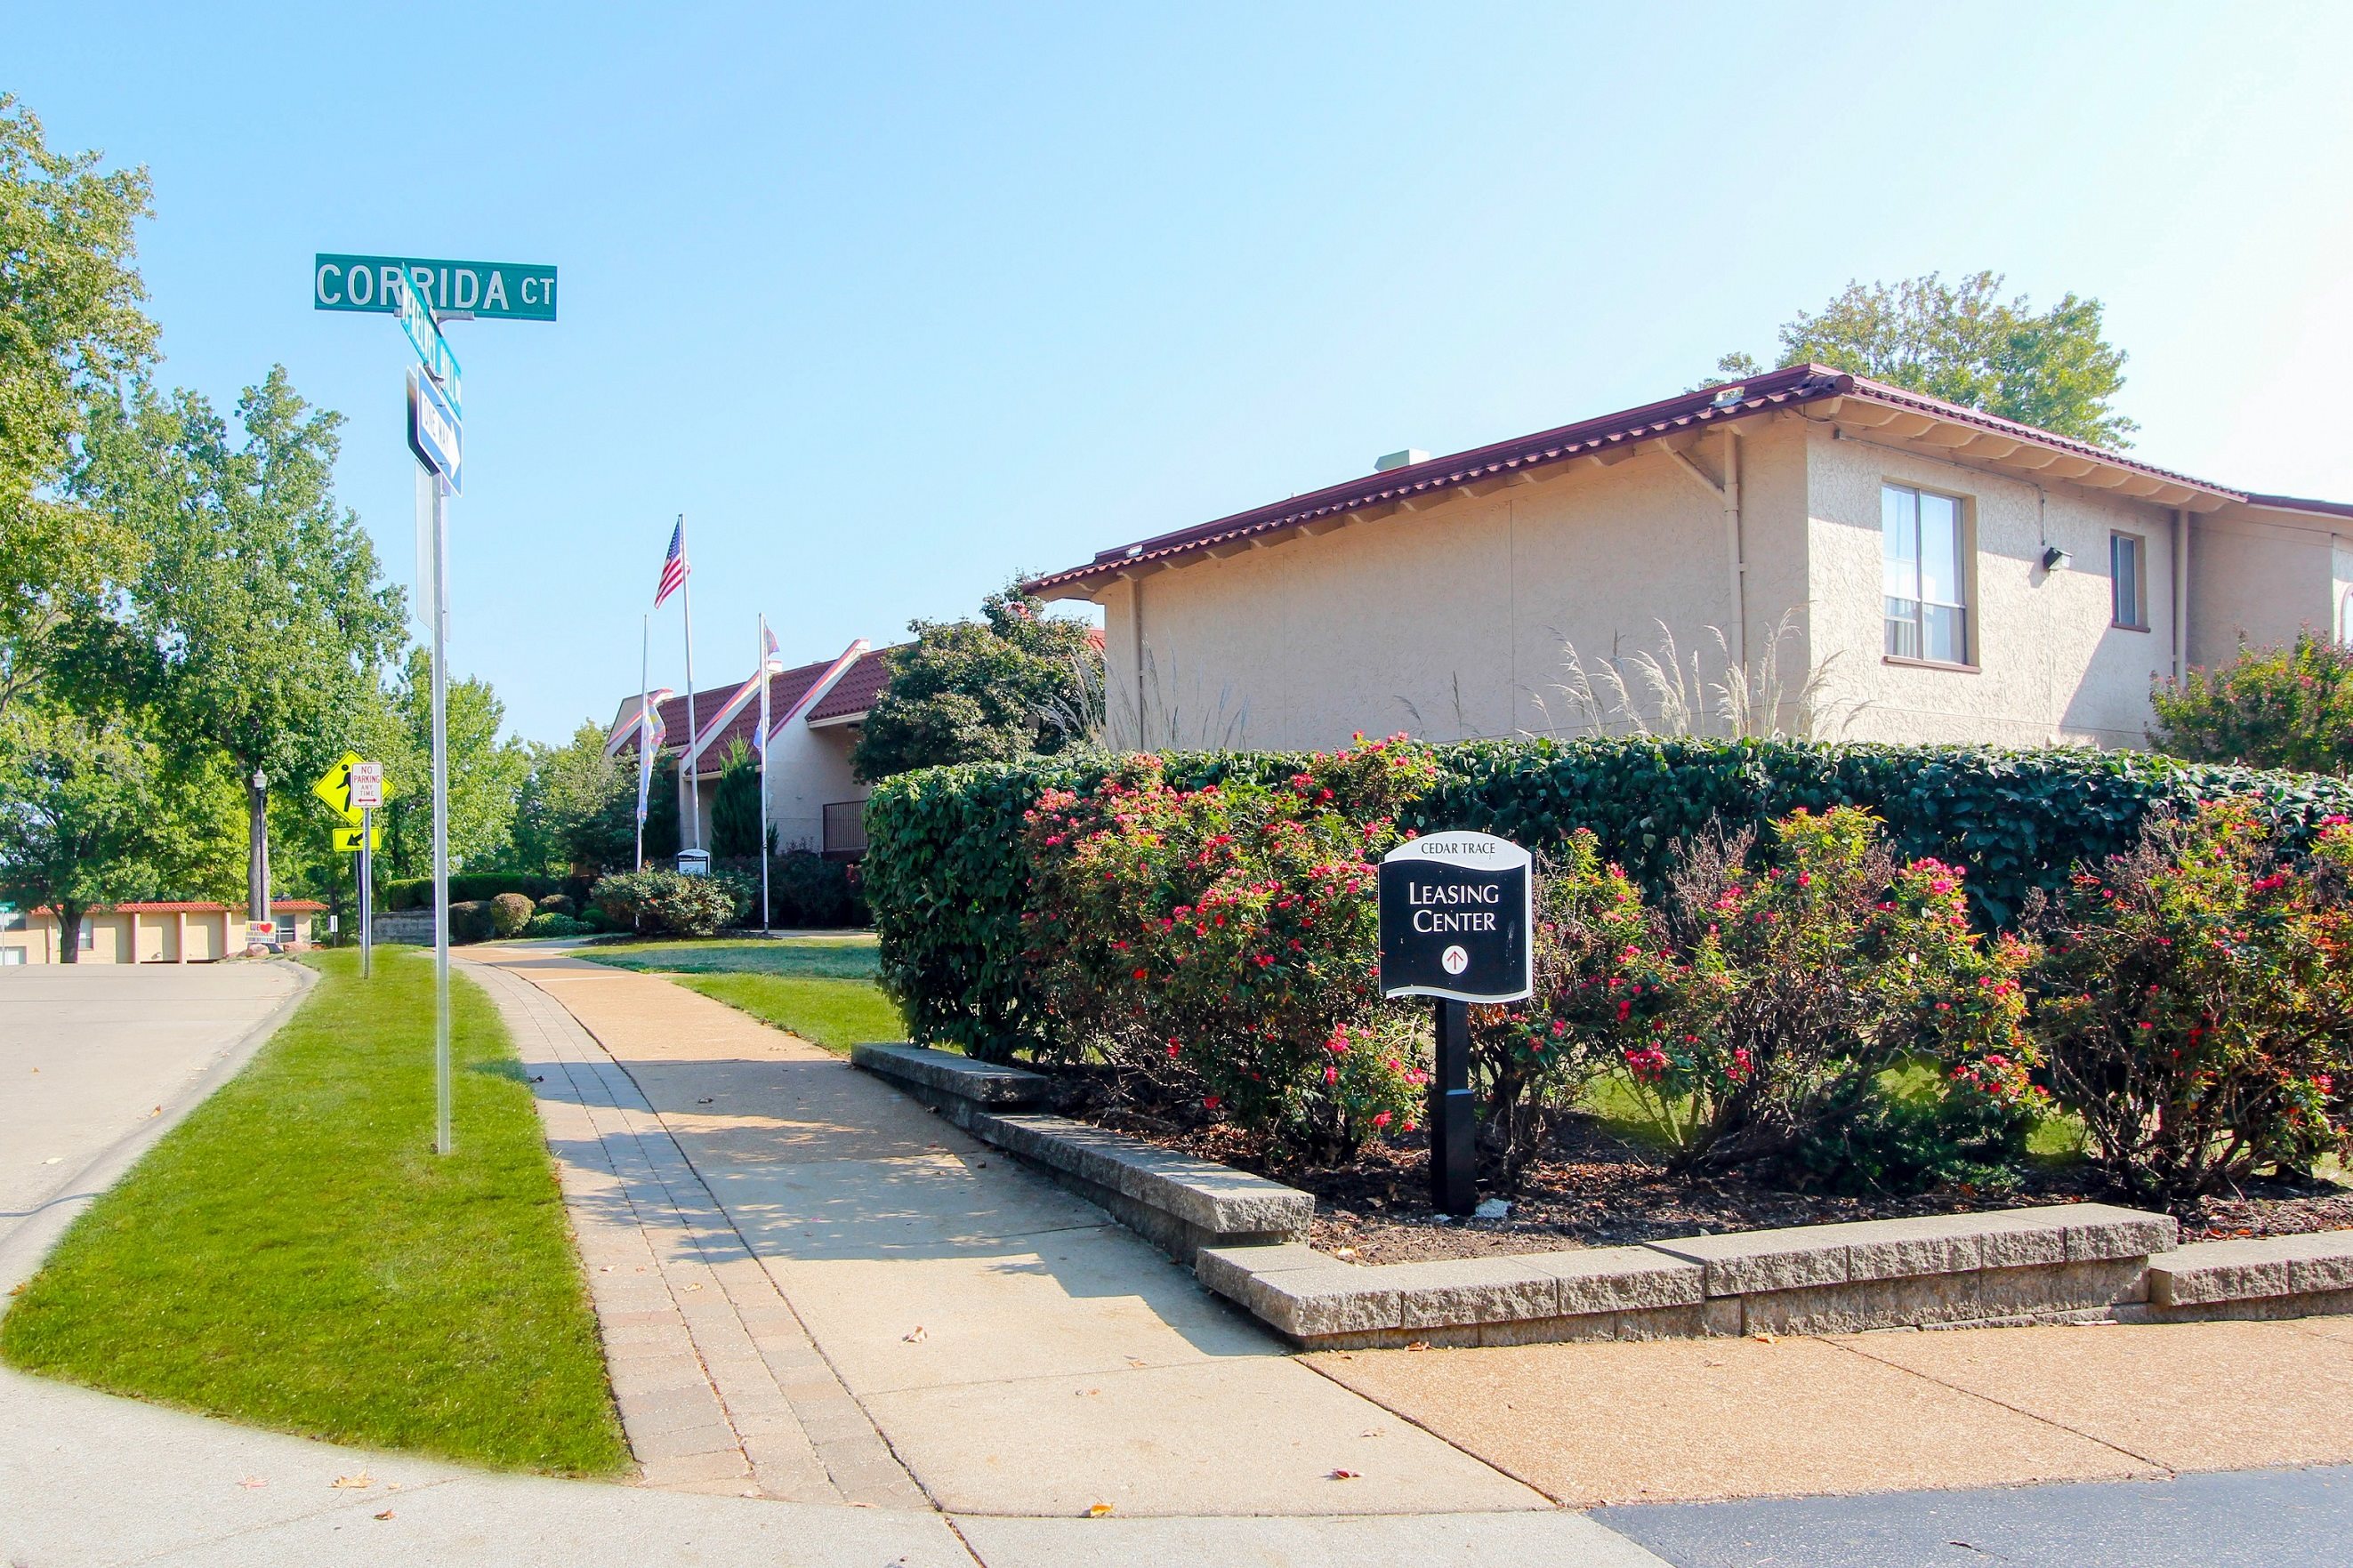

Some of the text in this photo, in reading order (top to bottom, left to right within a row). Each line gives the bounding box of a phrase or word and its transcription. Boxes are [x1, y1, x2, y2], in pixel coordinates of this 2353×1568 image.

[317, 264, 555, 310] CORRIDA CT
[361, 766, 373, 774] NO
[1421, 842, 1495, 854] CEDAR TRACE
[1409, 881, 1499, 905] LEASING
[250, 922, 260, 930] WE
[1413, 909, 1496, 933] CENTER
